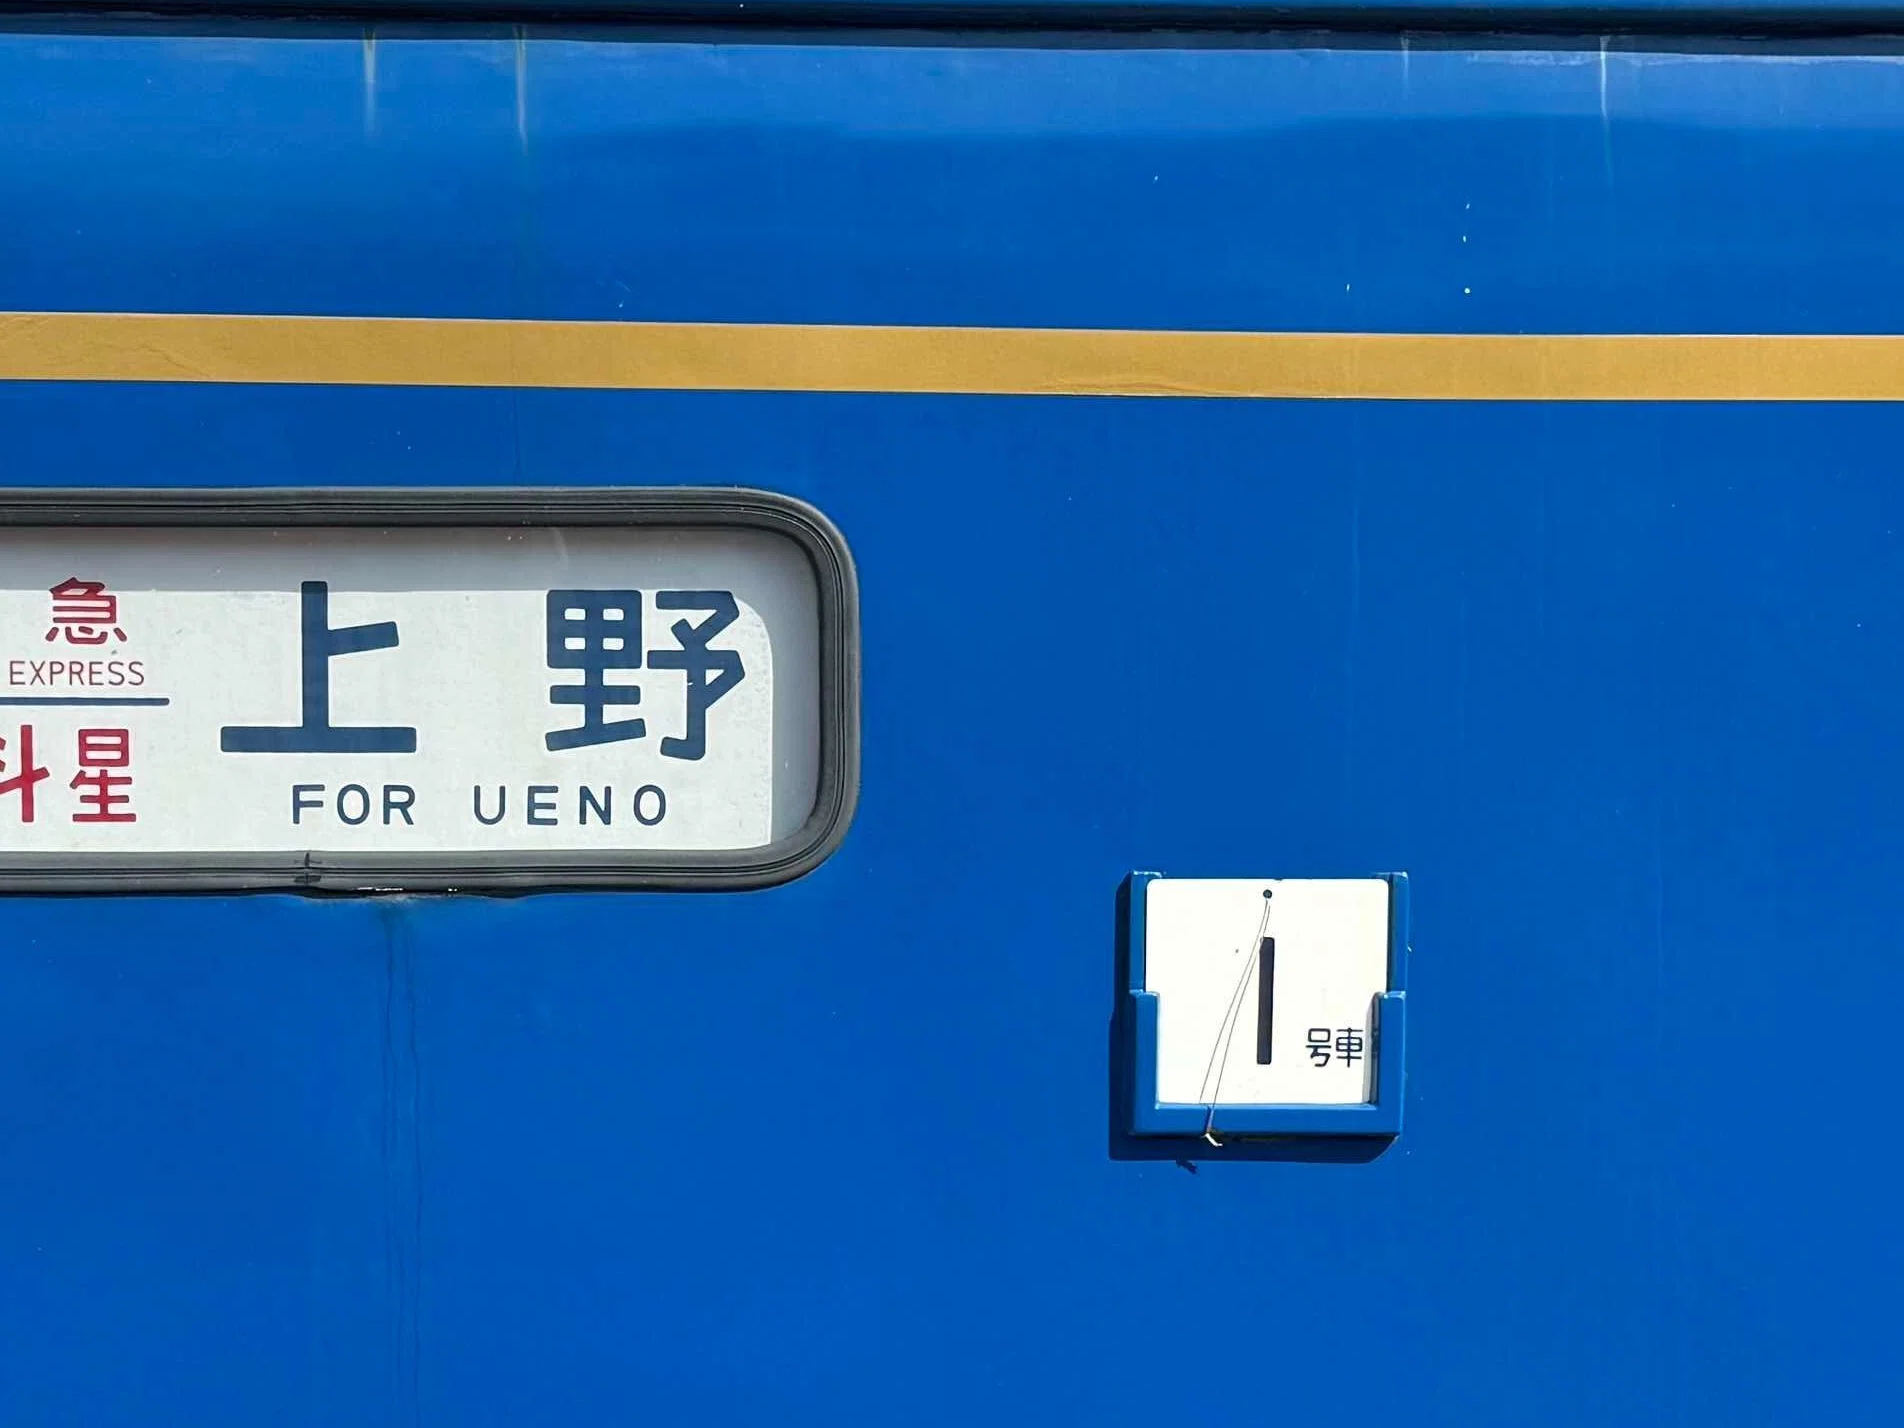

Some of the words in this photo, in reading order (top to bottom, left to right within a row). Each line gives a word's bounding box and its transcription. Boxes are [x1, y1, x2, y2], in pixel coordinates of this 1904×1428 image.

[8, 660, 145, 686] EXPRESS
[220, 580, 746, 761] 上野
[293, 783, 414, 826] FOR
[473, 783, 669, 826] UENO
[1305, 1027, 1364, 1068] 号車
